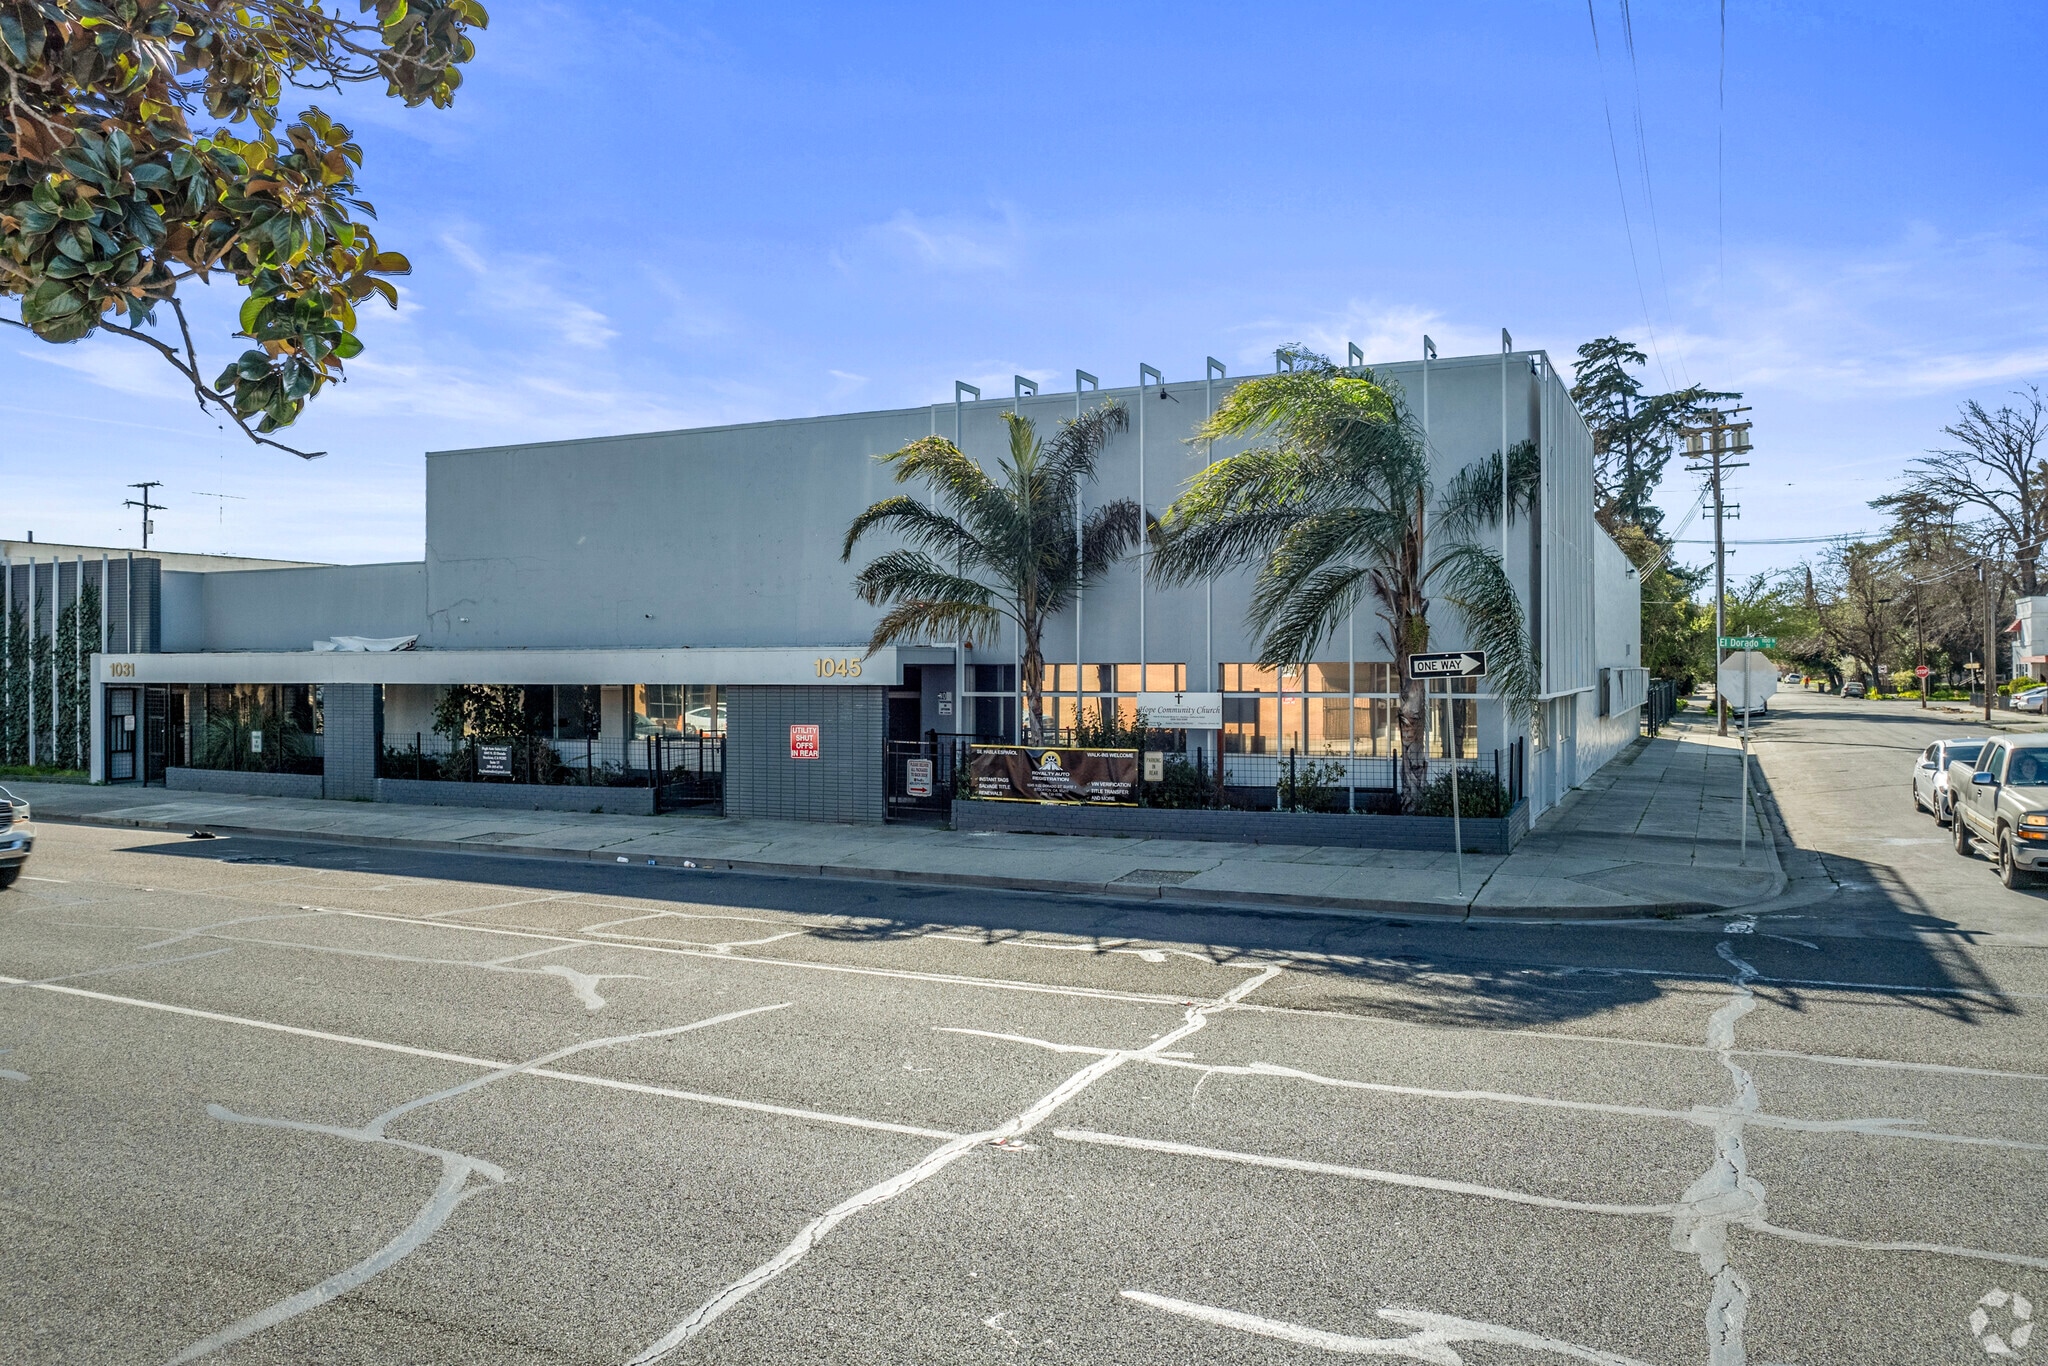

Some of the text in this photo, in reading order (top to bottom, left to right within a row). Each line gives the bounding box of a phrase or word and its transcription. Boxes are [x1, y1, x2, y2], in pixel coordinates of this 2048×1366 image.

[1720, 639, 1759, 647] El Dorado
[109, 662, 135, 677] 1031
[814, 658, 862, 677] 1045
[1417, 660, 1461, 671] ONE WAY
[1140, 706, 1220, 716] Hope Community Church
